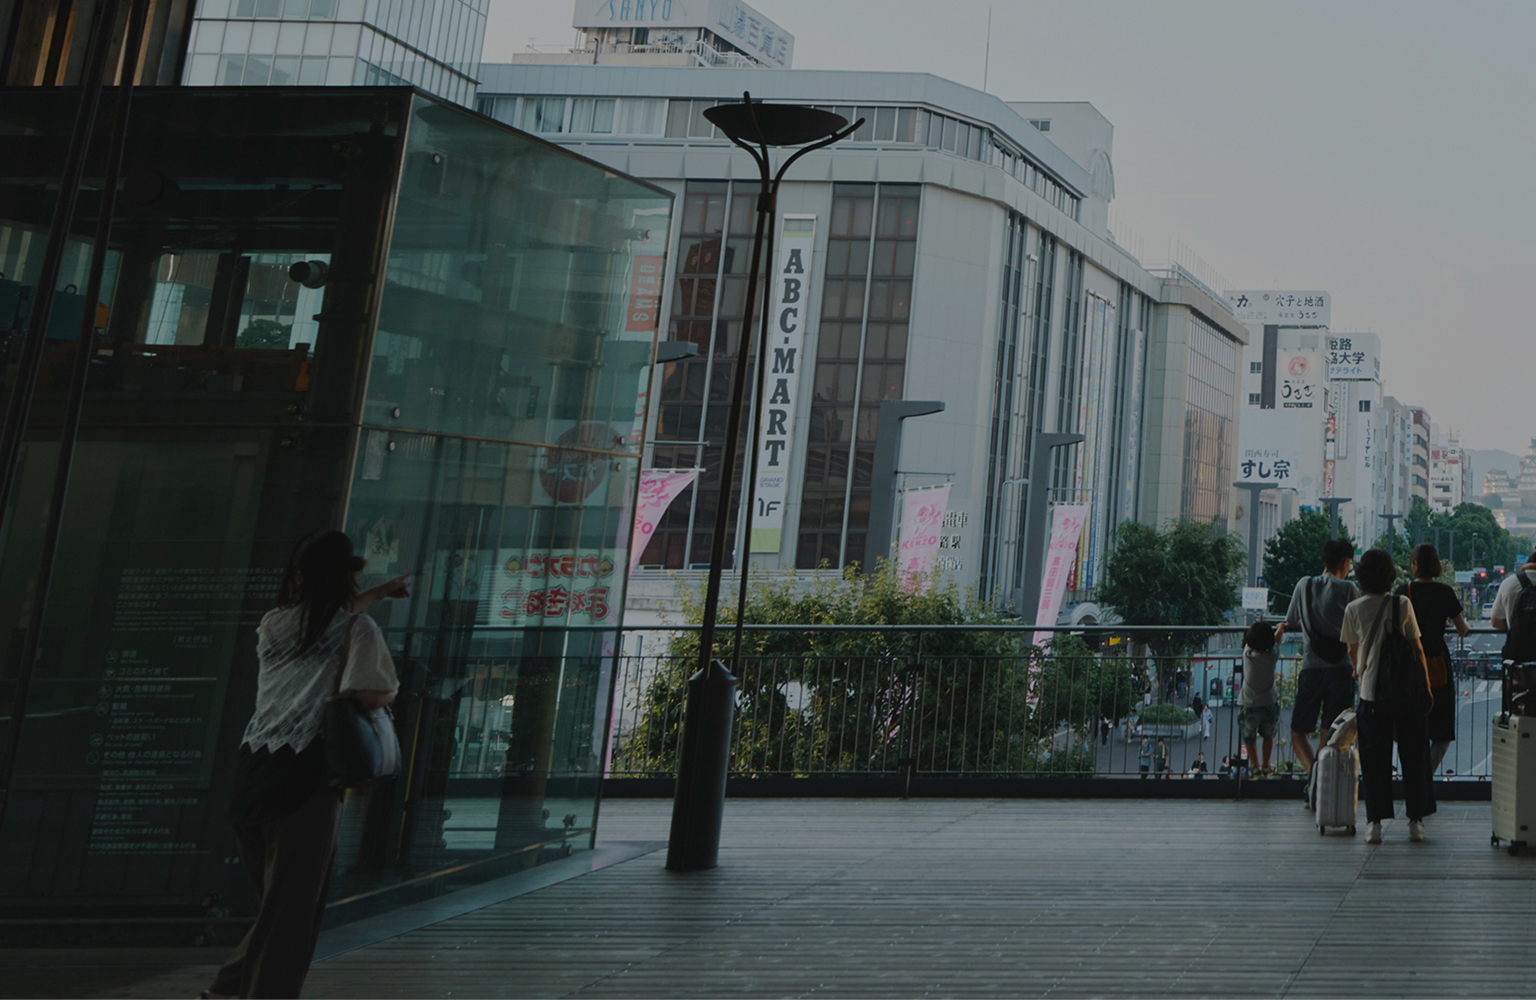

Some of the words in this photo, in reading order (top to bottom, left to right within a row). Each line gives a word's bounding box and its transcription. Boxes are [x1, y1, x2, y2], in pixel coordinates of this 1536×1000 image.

[1275, 294, 1324, 307] 穴子と地酒
[1281, 380, 1315, 400] うさぎ
[1241, 460, 1290, 479] すし宗
[758, 497, 781, 517] 1F
[902, 535, 937, 551] KENZO
[1049, 542, 1075, 551] KENZO
